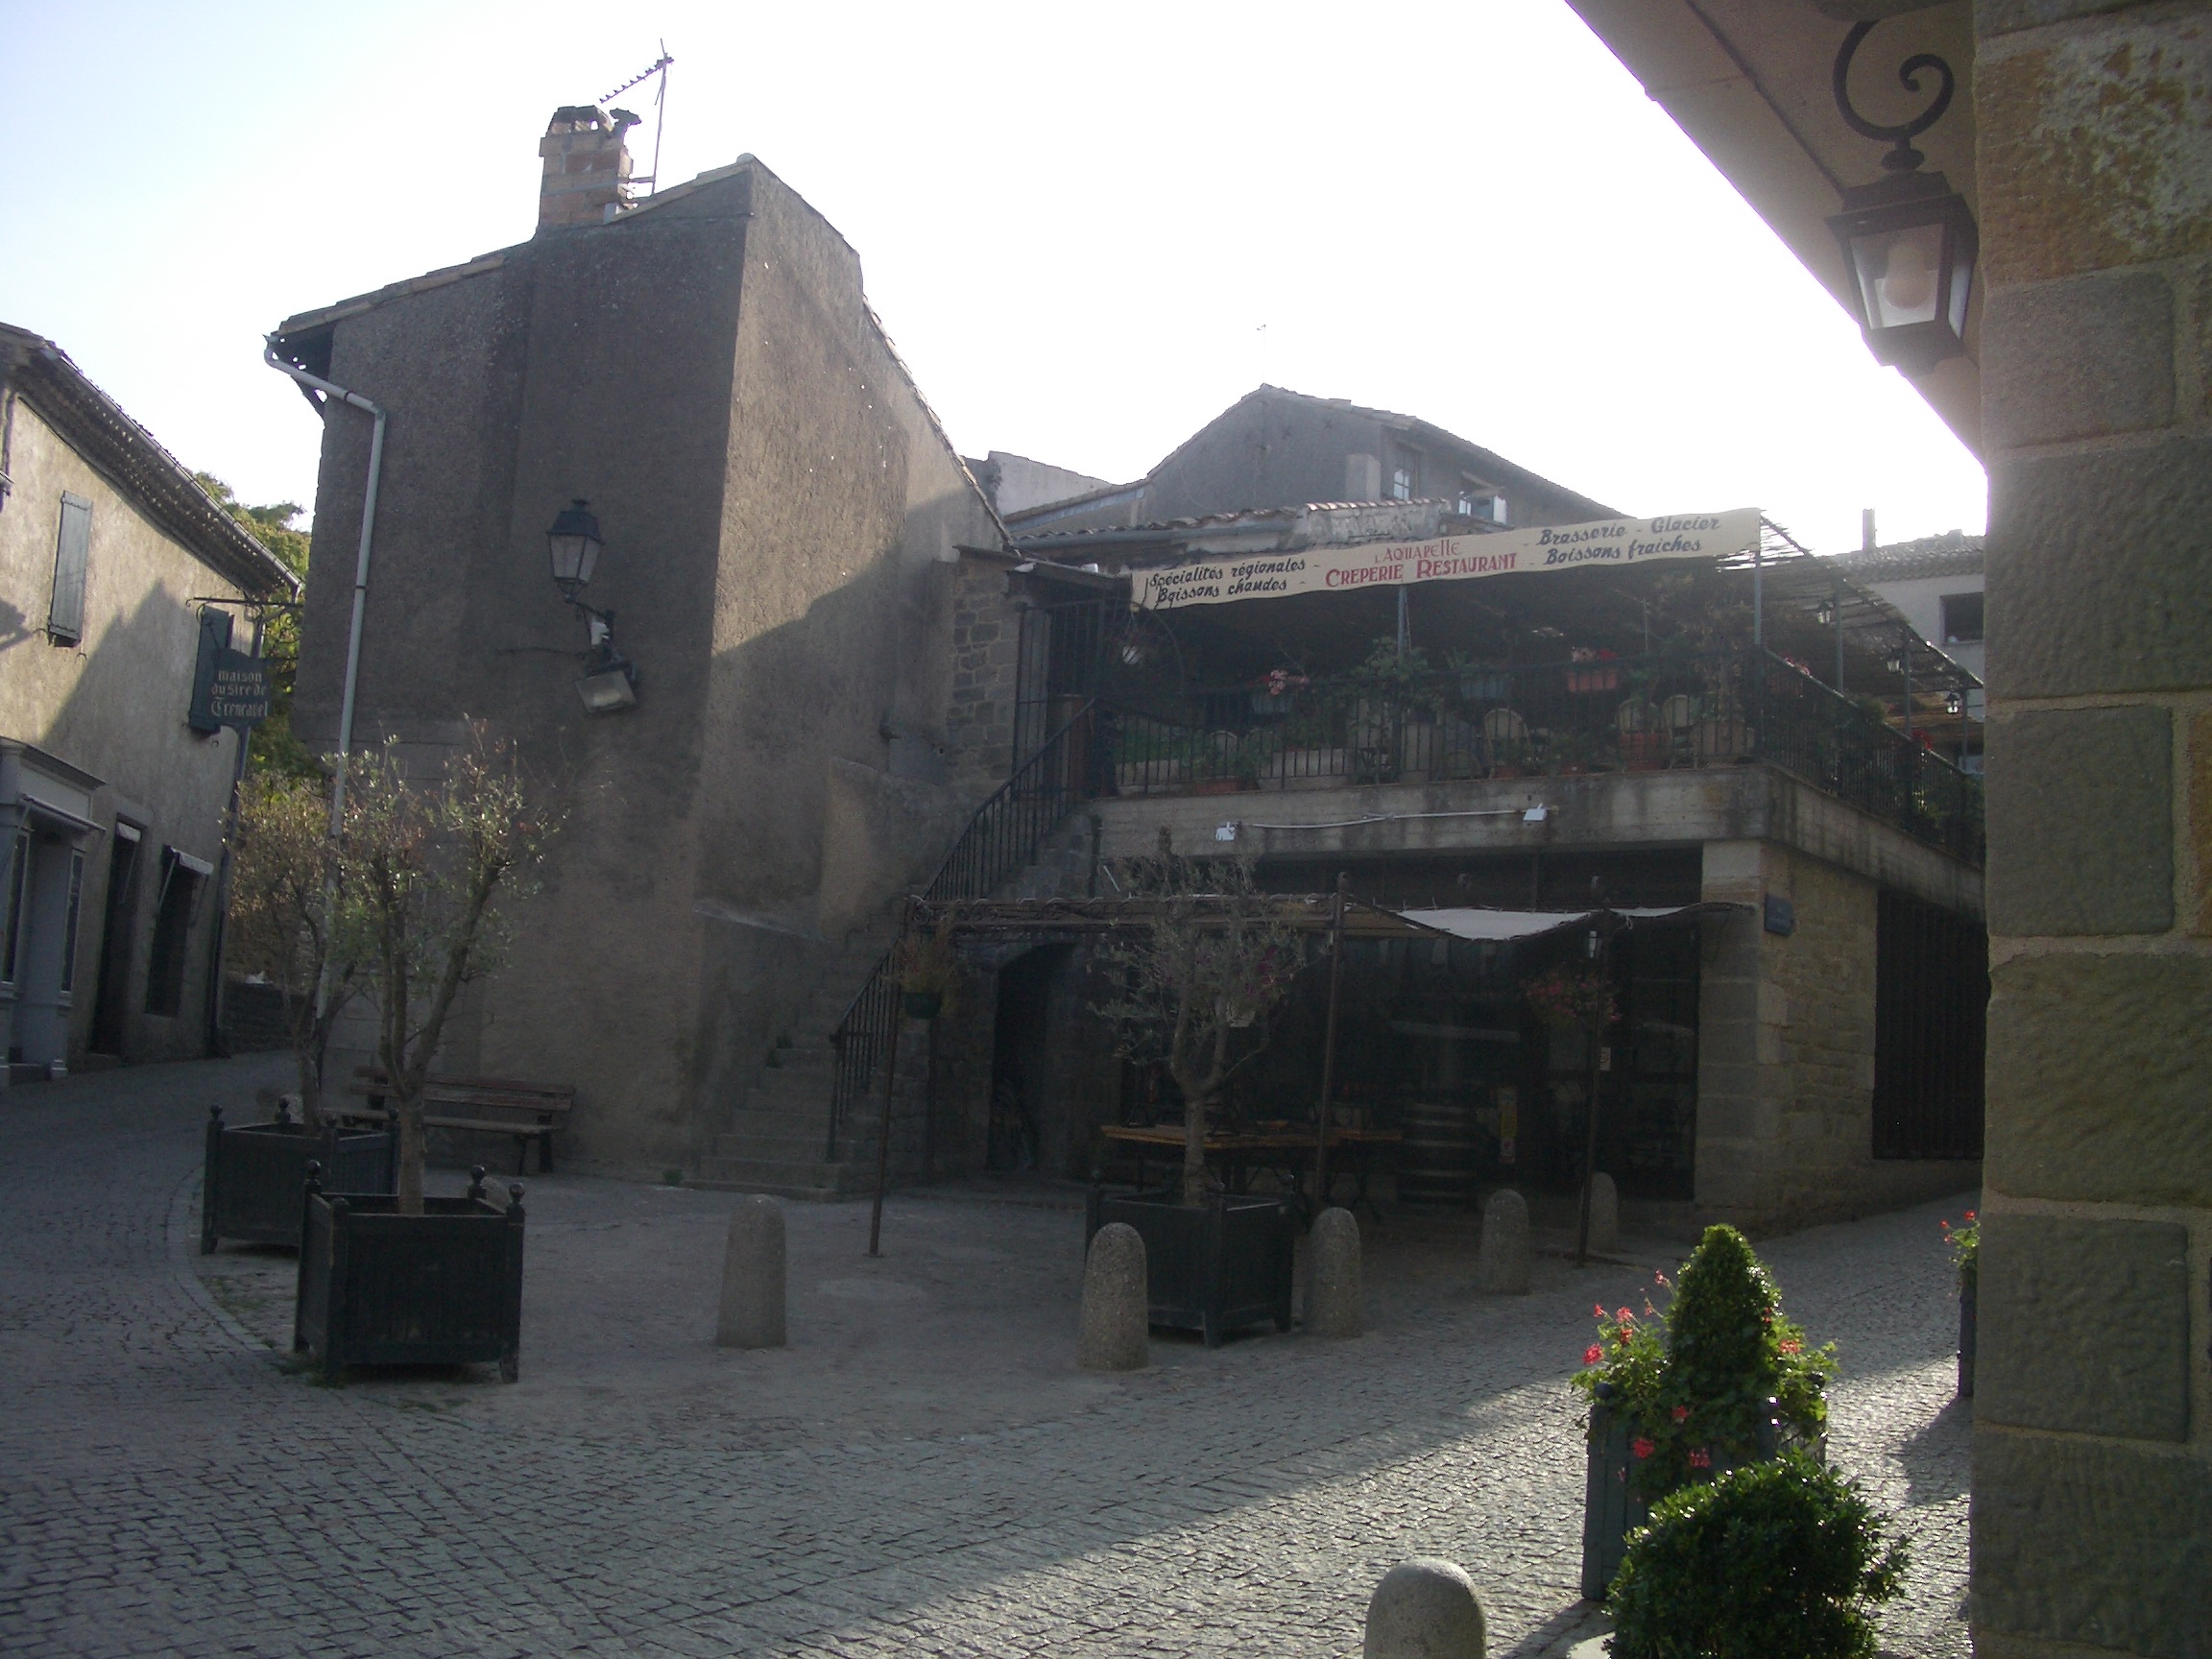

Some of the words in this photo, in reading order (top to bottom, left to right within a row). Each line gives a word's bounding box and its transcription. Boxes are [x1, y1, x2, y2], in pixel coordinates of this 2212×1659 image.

[1537, 523, 1627, 545] Brasserie
[1650, 517, 1720, 534] Glacier
[1544, 545, 1621, 565] Boissons
[1149, 565, 1223, 589] Spécialités
[1231, 558, 1306, 580] régionales
[1325, 564, 1404, 588] CREPERIE
[1416, 553, 1517, 579] RESTAURANT
[1157, 585, 1219, 604] Boissons
[1227, 578, 1286, 595] chaudes
